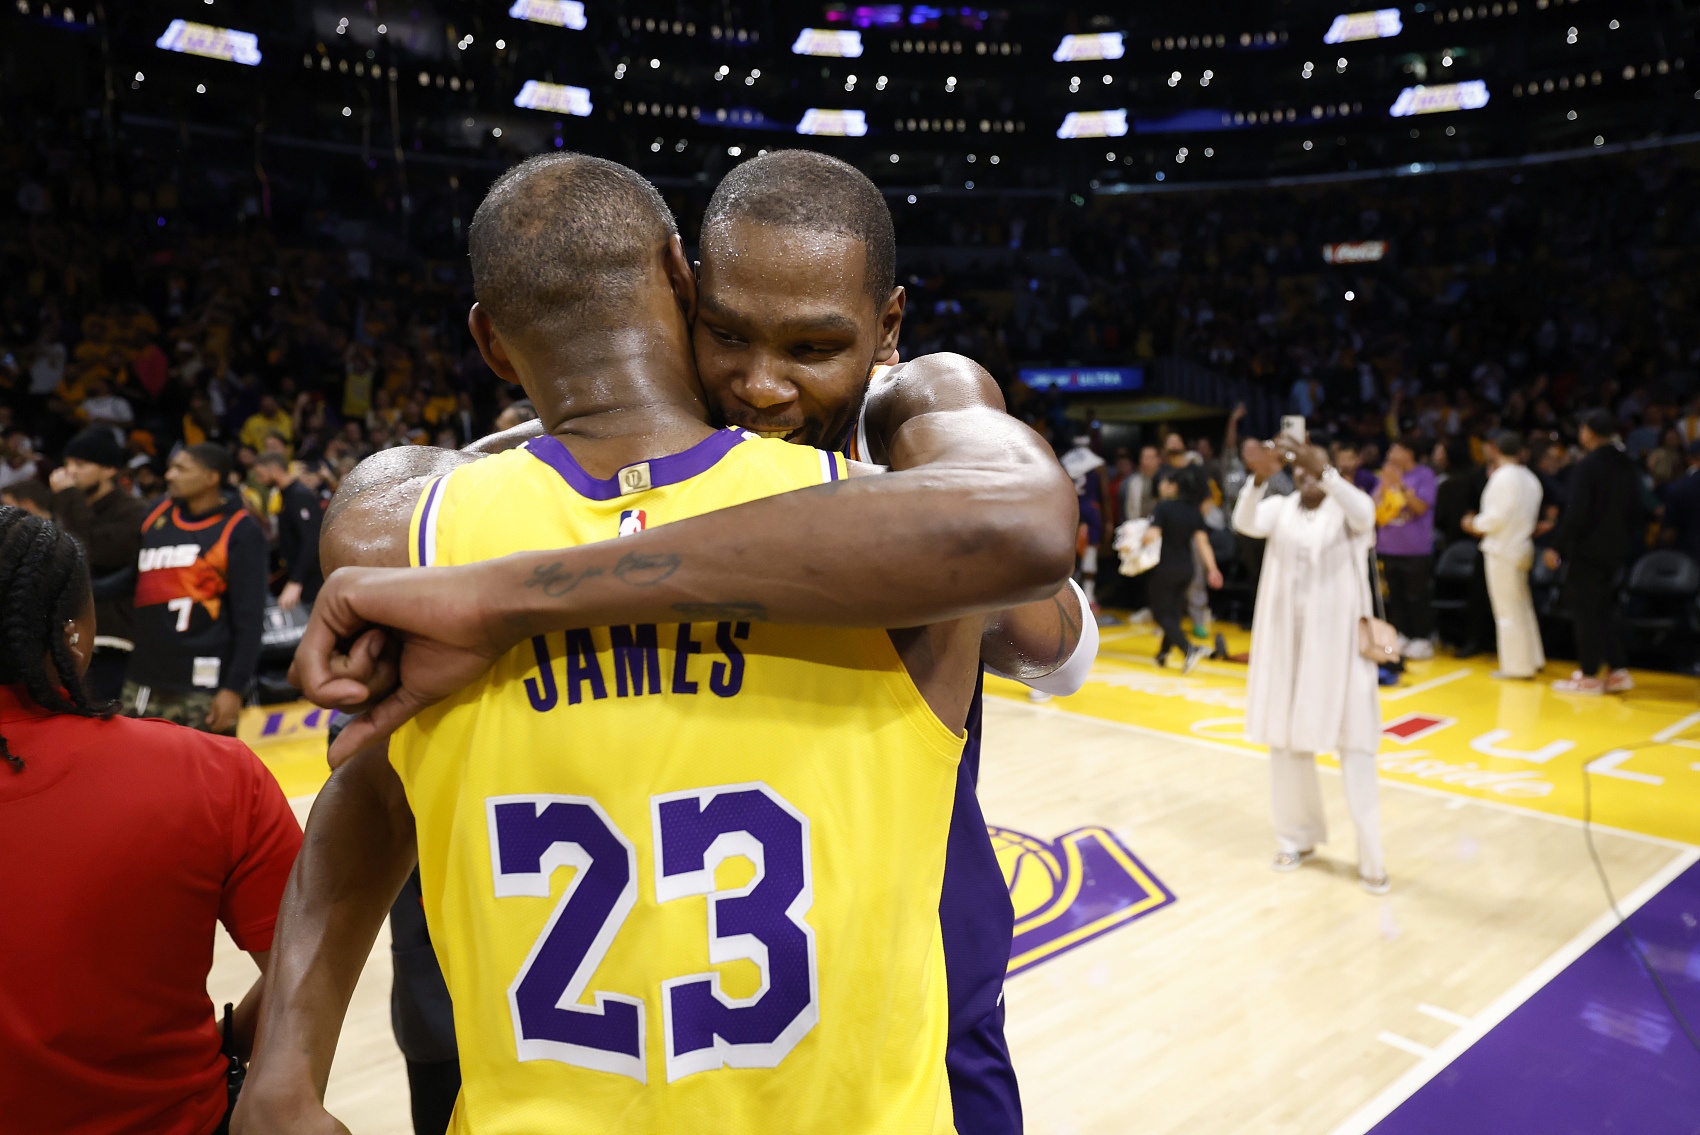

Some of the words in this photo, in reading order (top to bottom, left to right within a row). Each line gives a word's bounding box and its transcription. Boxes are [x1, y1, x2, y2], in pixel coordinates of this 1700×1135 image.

[168, 596, 194, 632] 7
[523, 621, 750, 712] JAMES
[485, 780, 820, 1085] 23
